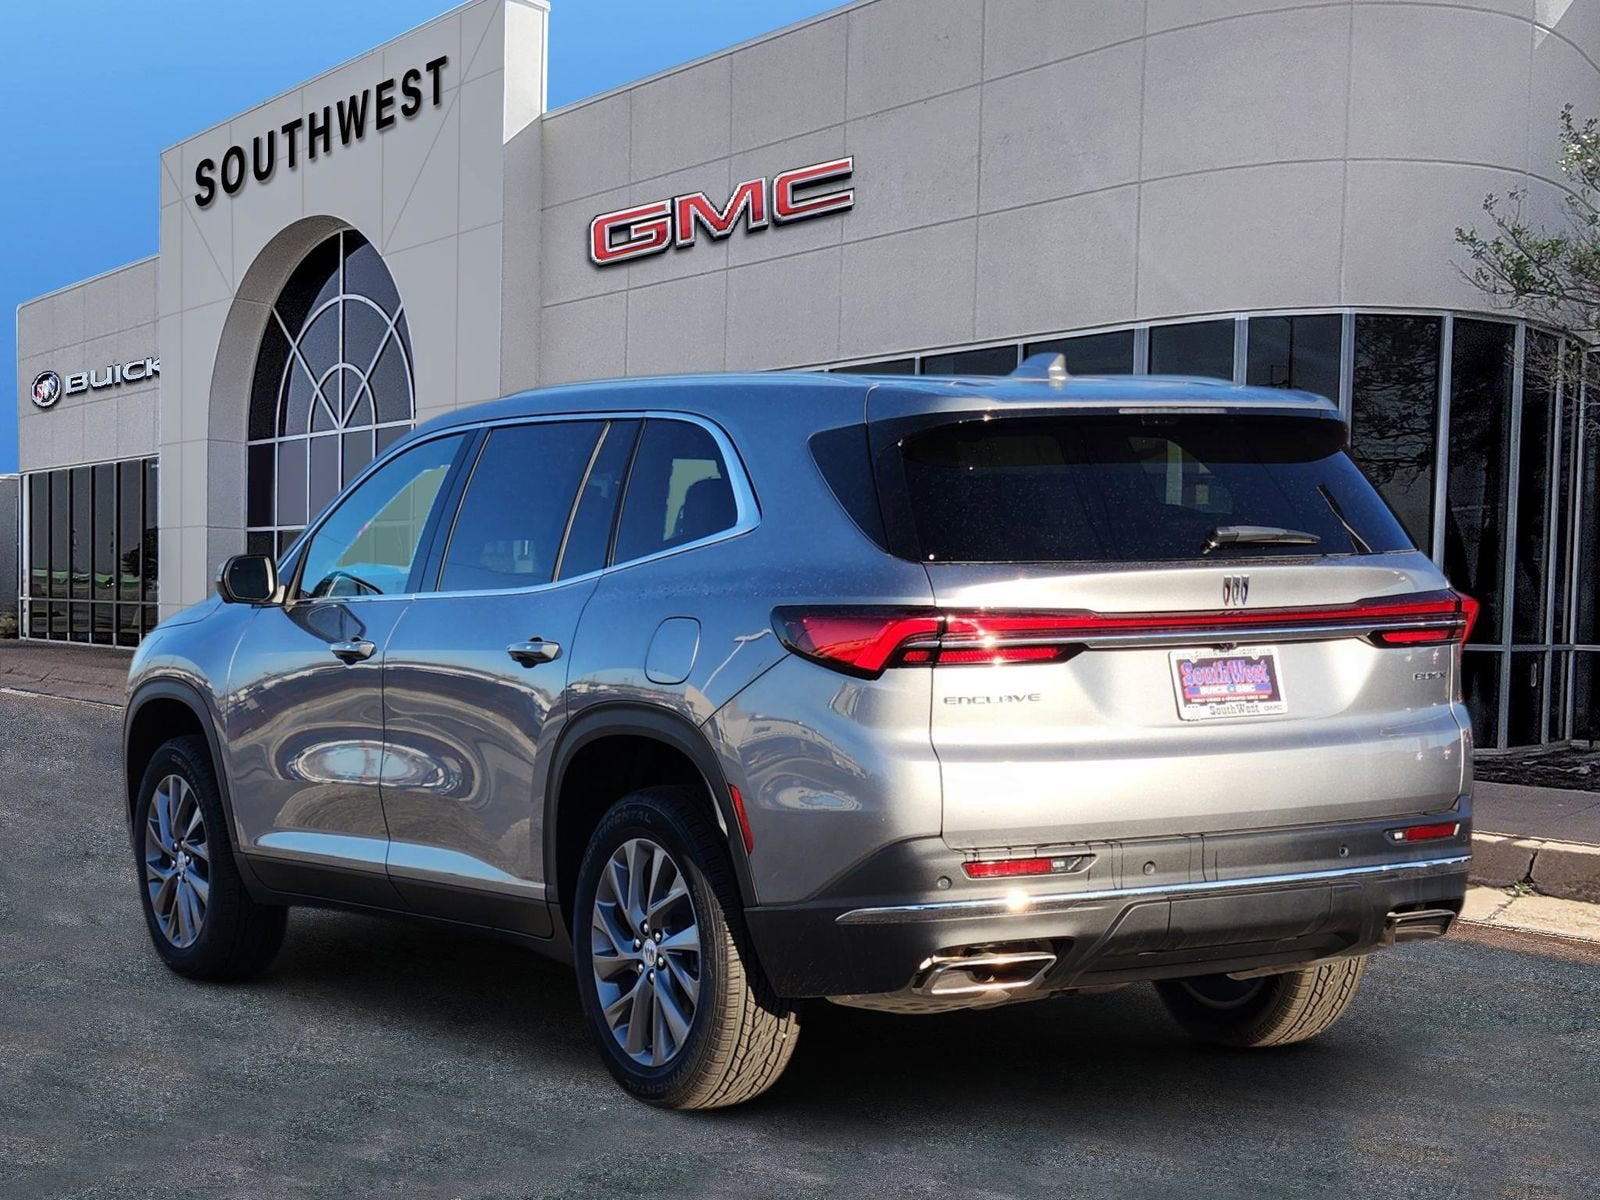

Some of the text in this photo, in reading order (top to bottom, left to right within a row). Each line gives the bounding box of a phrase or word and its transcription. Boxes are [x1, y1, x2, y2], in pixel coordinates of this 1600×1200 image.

[194, 55, 447, 208] SOUTHWEST
[590, 155, 854, 265] GMC
[65, 356, 160, 395] BUICK
[943, 693, 1041, 705] ENCLAVE
